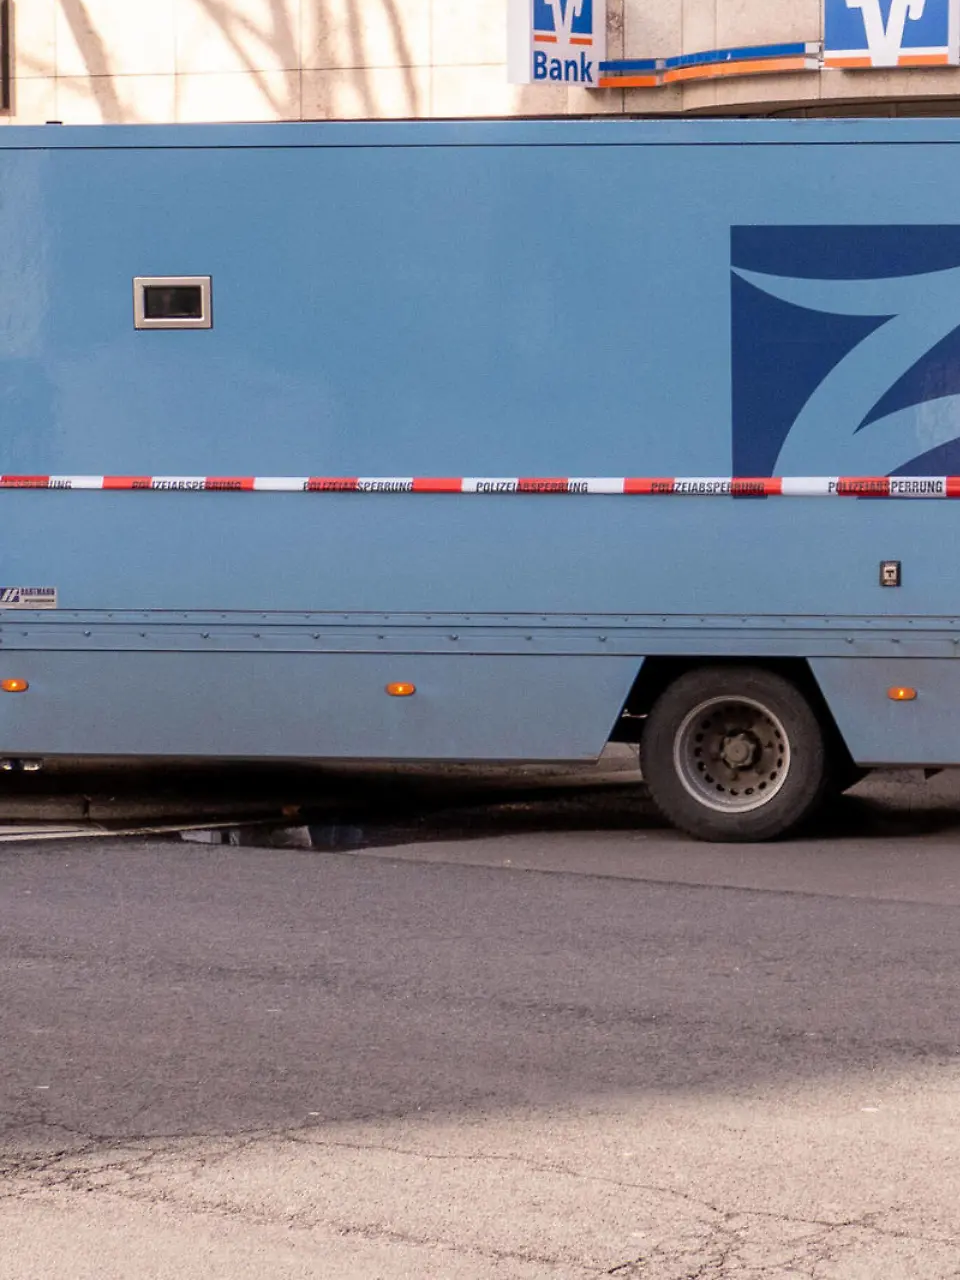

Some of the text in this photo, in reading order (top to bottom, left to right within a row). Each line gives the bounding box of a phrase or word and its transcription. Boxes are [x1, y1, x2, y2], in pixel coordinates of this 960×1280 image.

[533, 50, 593, 82] Bank
[476, 482, 588, 493] POLIZEIABSPERRUNG
[651, 481, 765, 493] POLIZEIABSPERRUNG
[828, 481, 943, 493] POLIZEIABSPERRUNG
